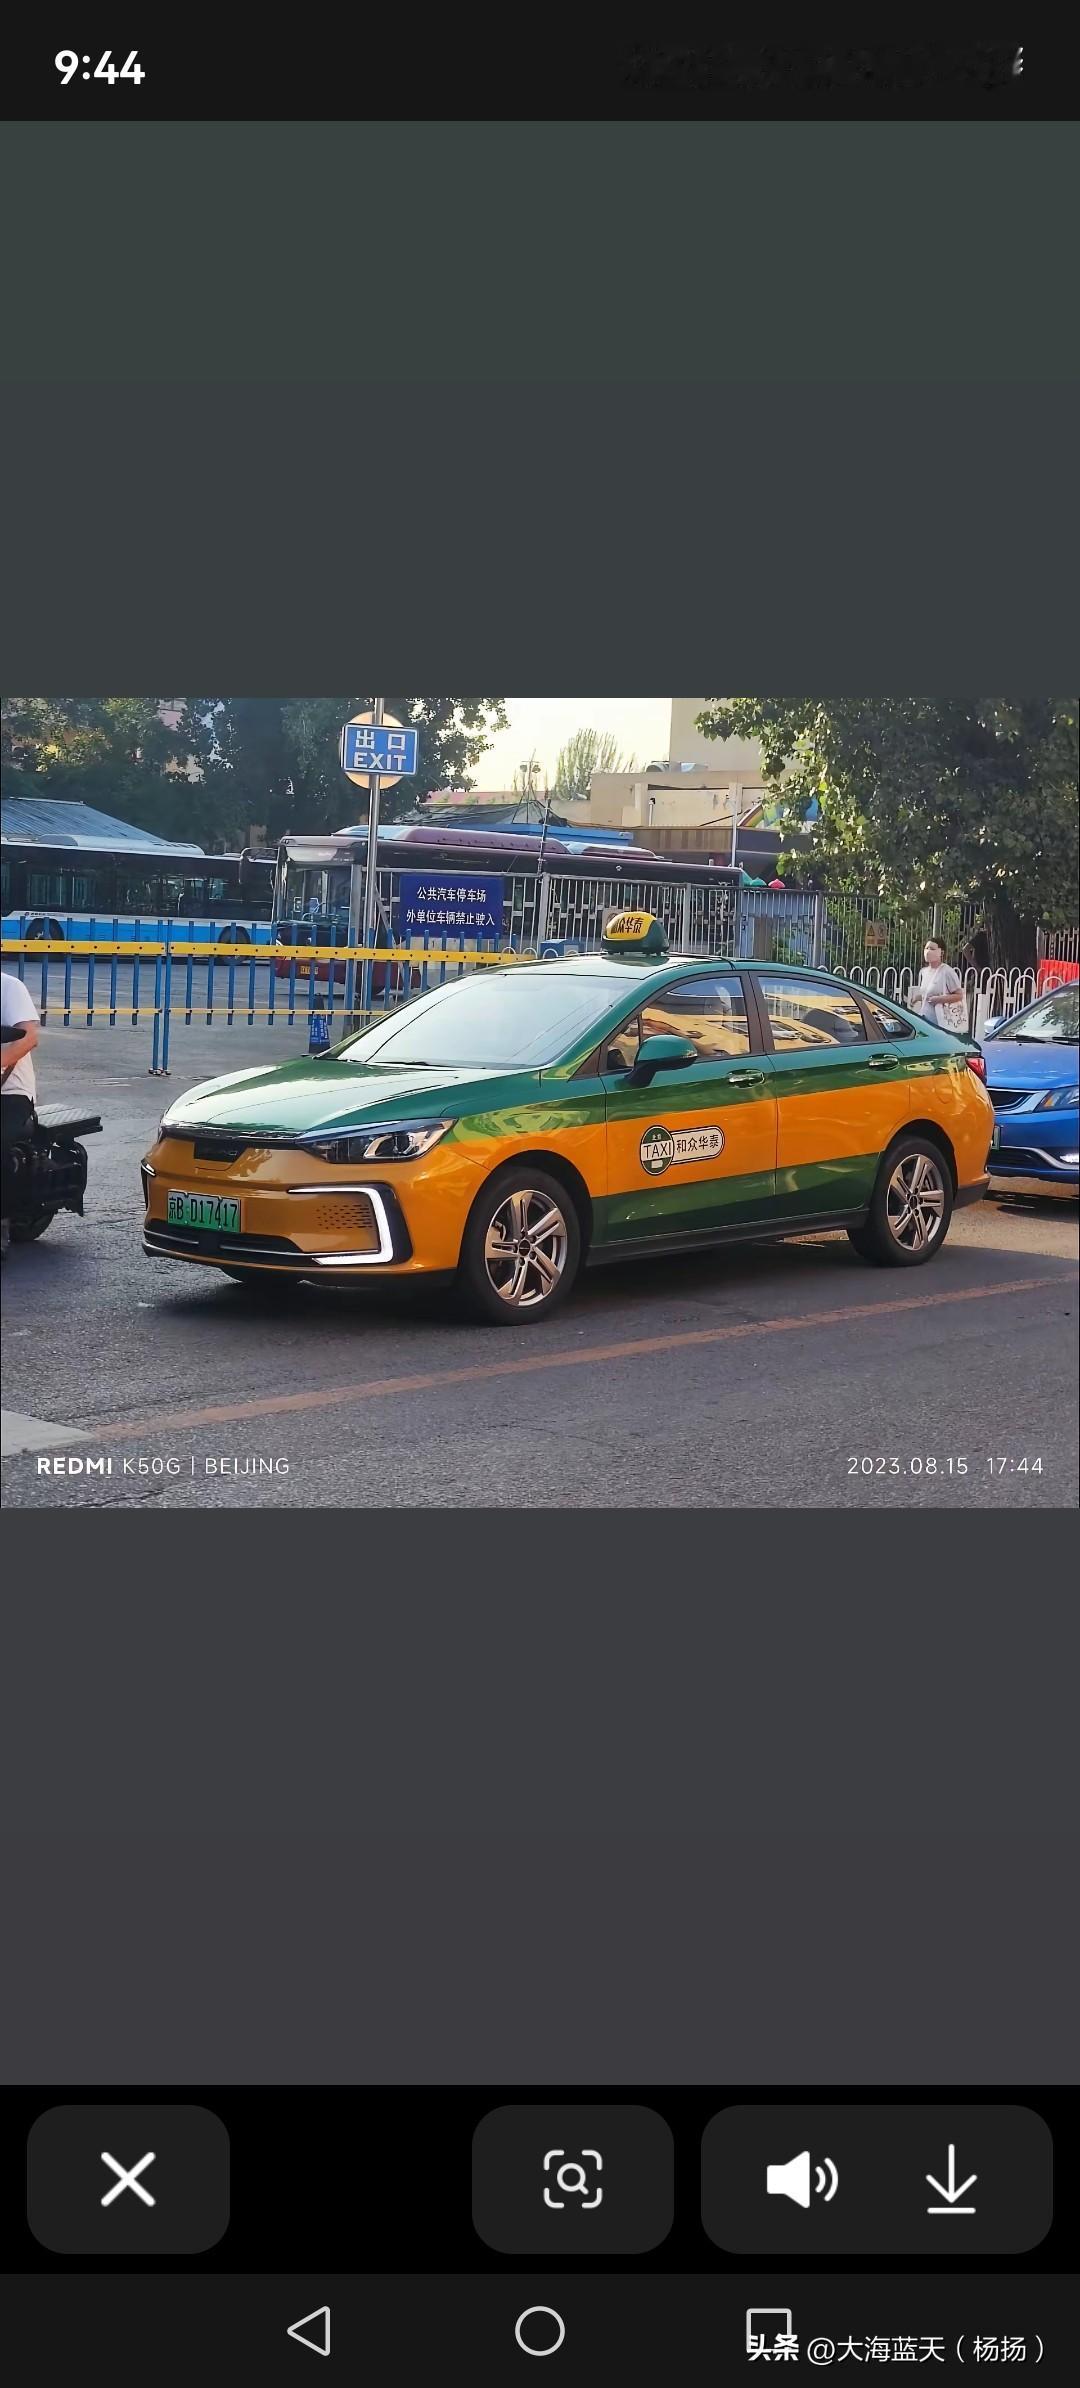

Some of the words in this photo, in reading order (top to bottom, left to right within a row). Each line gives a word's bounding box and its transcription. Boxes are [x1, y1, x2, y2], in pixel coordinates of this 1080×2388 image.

[54, 49, 146, 85] 9:44
[355, 729, 406, 751] 出口
[353, 751, 407, 771] EXIT
[417, 886, 487, 903] 公共汽车停车场
[406, 909, 495, 926] 外单位车辆禁止驶入
[643, 1142, 672, 1159] TAXI
[676, 1134, 719, 1153] 和众华泰
